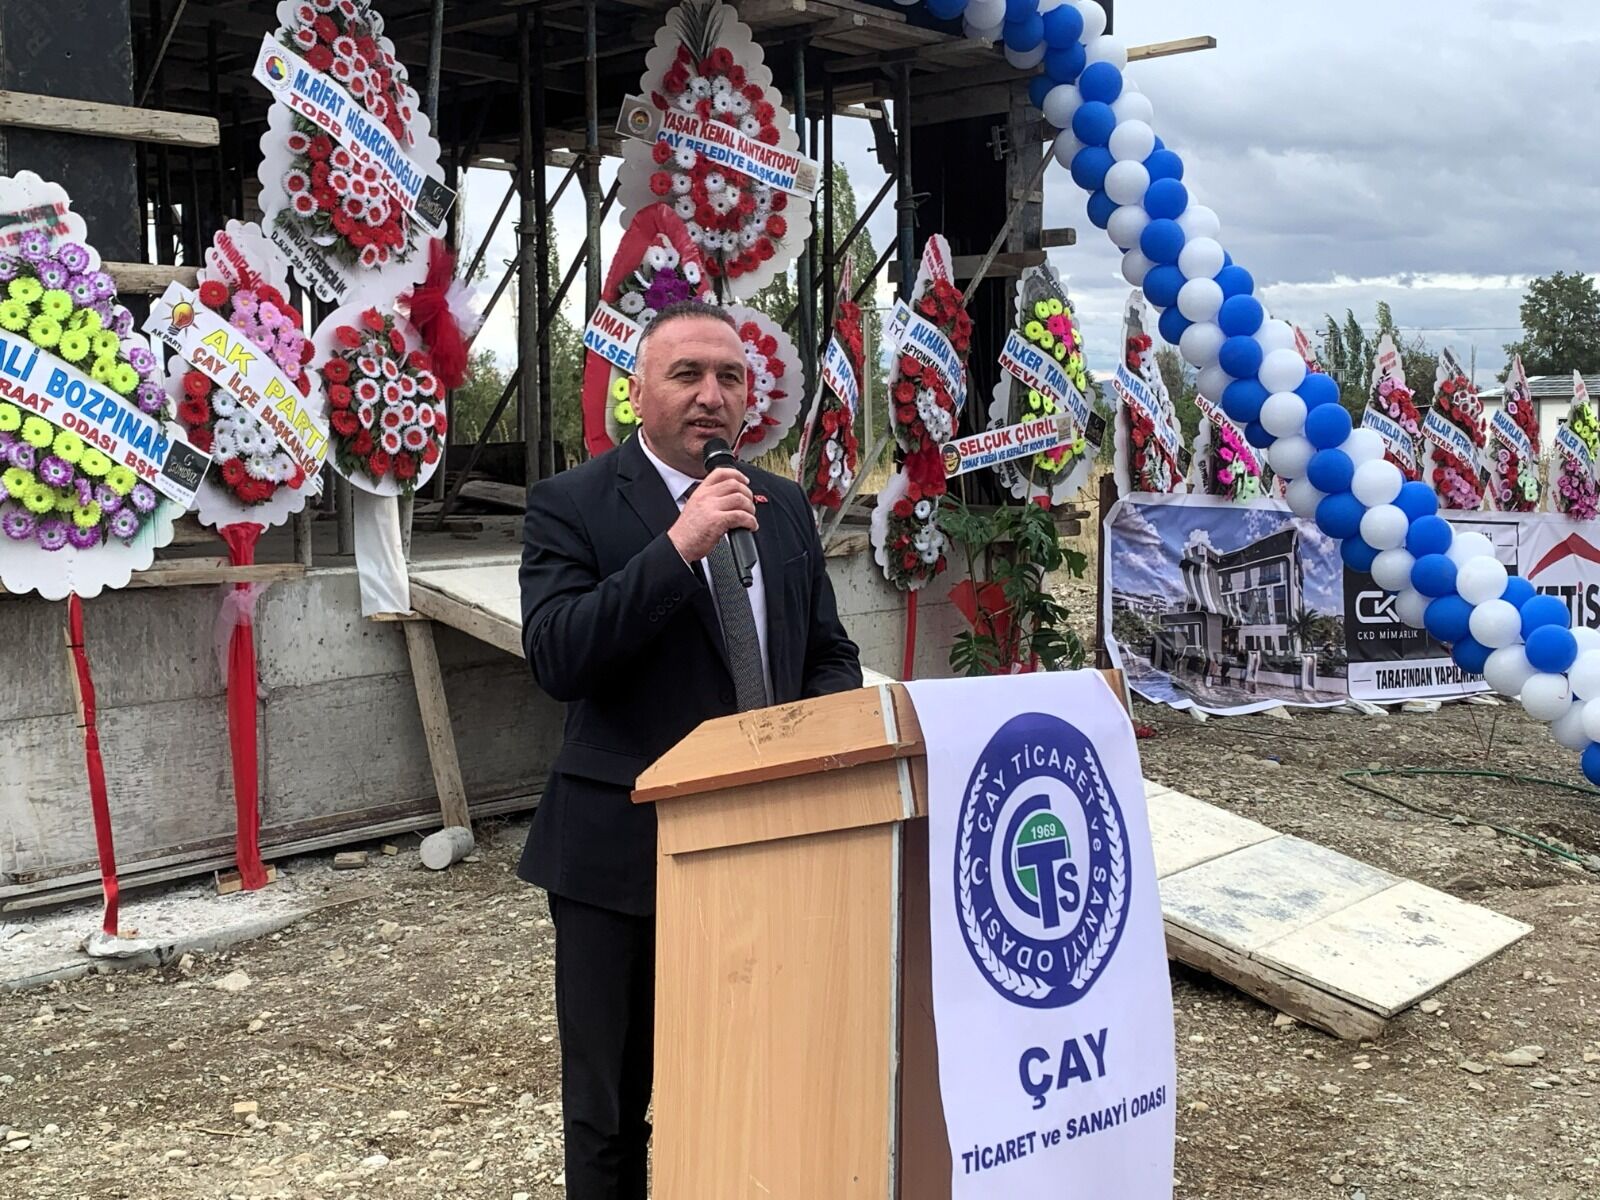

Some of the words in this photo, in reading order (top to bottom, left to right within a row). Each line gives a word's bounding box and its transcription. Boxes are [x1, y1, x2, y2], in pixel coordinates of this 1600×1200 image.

[290, 92, 343, 138] TOBB
[349, 139, 414, 212] BAKANI
[293, 68, 345, 117] M.RİFAT
[344, 108, 422, 197] HİSARCIKLIOĞLU
[664, 110, 699, 137] YAŞAR
[699, 121, 735, 148] KEMAL
[737, 135, 800, 175] KANTARTOPU
[686, 138, 745, 168] BELEDİYE
[747, 160, 794, 189] BAŞKANI
[291, 255, 307, 274] 201
[151, 328, 163, 340] AK
[592, 308, 636, 343] UMAY
[889, 319, 905, 340] İYİ
[909, 322, 951, 365] AV.HAKAN
[200, 329, 258, 377] AK
[1006, 335, 1044, 373] ÜLKER
[1044, 364, 1069, 397] TARIM
[1000, 354, 1060, 404] MEVLÜT
[45, 367, 169, 466] BOZPINAR
[192, 347, 227, 376] ÇAY
[227, 372, 261, 409] İLÇE
[260, 405, 319, 477] BAŞKANLIĞI
[61, 412, 117, 454] ODASI
[124, 450, 160, 483] BŞK
[960, 430, 1012, 457] SELÇUK
[1015, 418, 1057, 445] ÇİVRİL
[962, 457, 980, 471] ESNAF
[980, 450, 997, 466] KREDİ
[998, 450, 1006, 460] VE
[1006, 443, 1029, 459] KEFALET
[1422, 425, 1454, 451] MUSTAFA
[1490, 422, 1520, 452] MEHMET
[1355, 590, 1400, 624] CK
[1536, 581, 1600, 630] TİS
[1357, 631, 1375, 640] CKD
[1379, 628, 1418, 640] MİMARLIK
[1376, 666, 1433, 690] TARAFINDAN
[1011, 744, 1095, 806] TİCARET
[978, 769, 1007, 833] ÇAY
[1030, 823, 1057, 840] 1969
[1090, 816, 1102, 852] ve
[980, 906, 1054, 972] ODASI
[1065, 865, 1107, 972] SANAYİ
[1018, 1027, 1108, 1110] ÇAY
[961, 1131, 1037, 1175] TİCARET
[1041, 1129, 1061, 1148] ve
[1066, 1097, 1127, 1140] SANAYİ
[1131, 1085, 1166, 1119] ODASI
